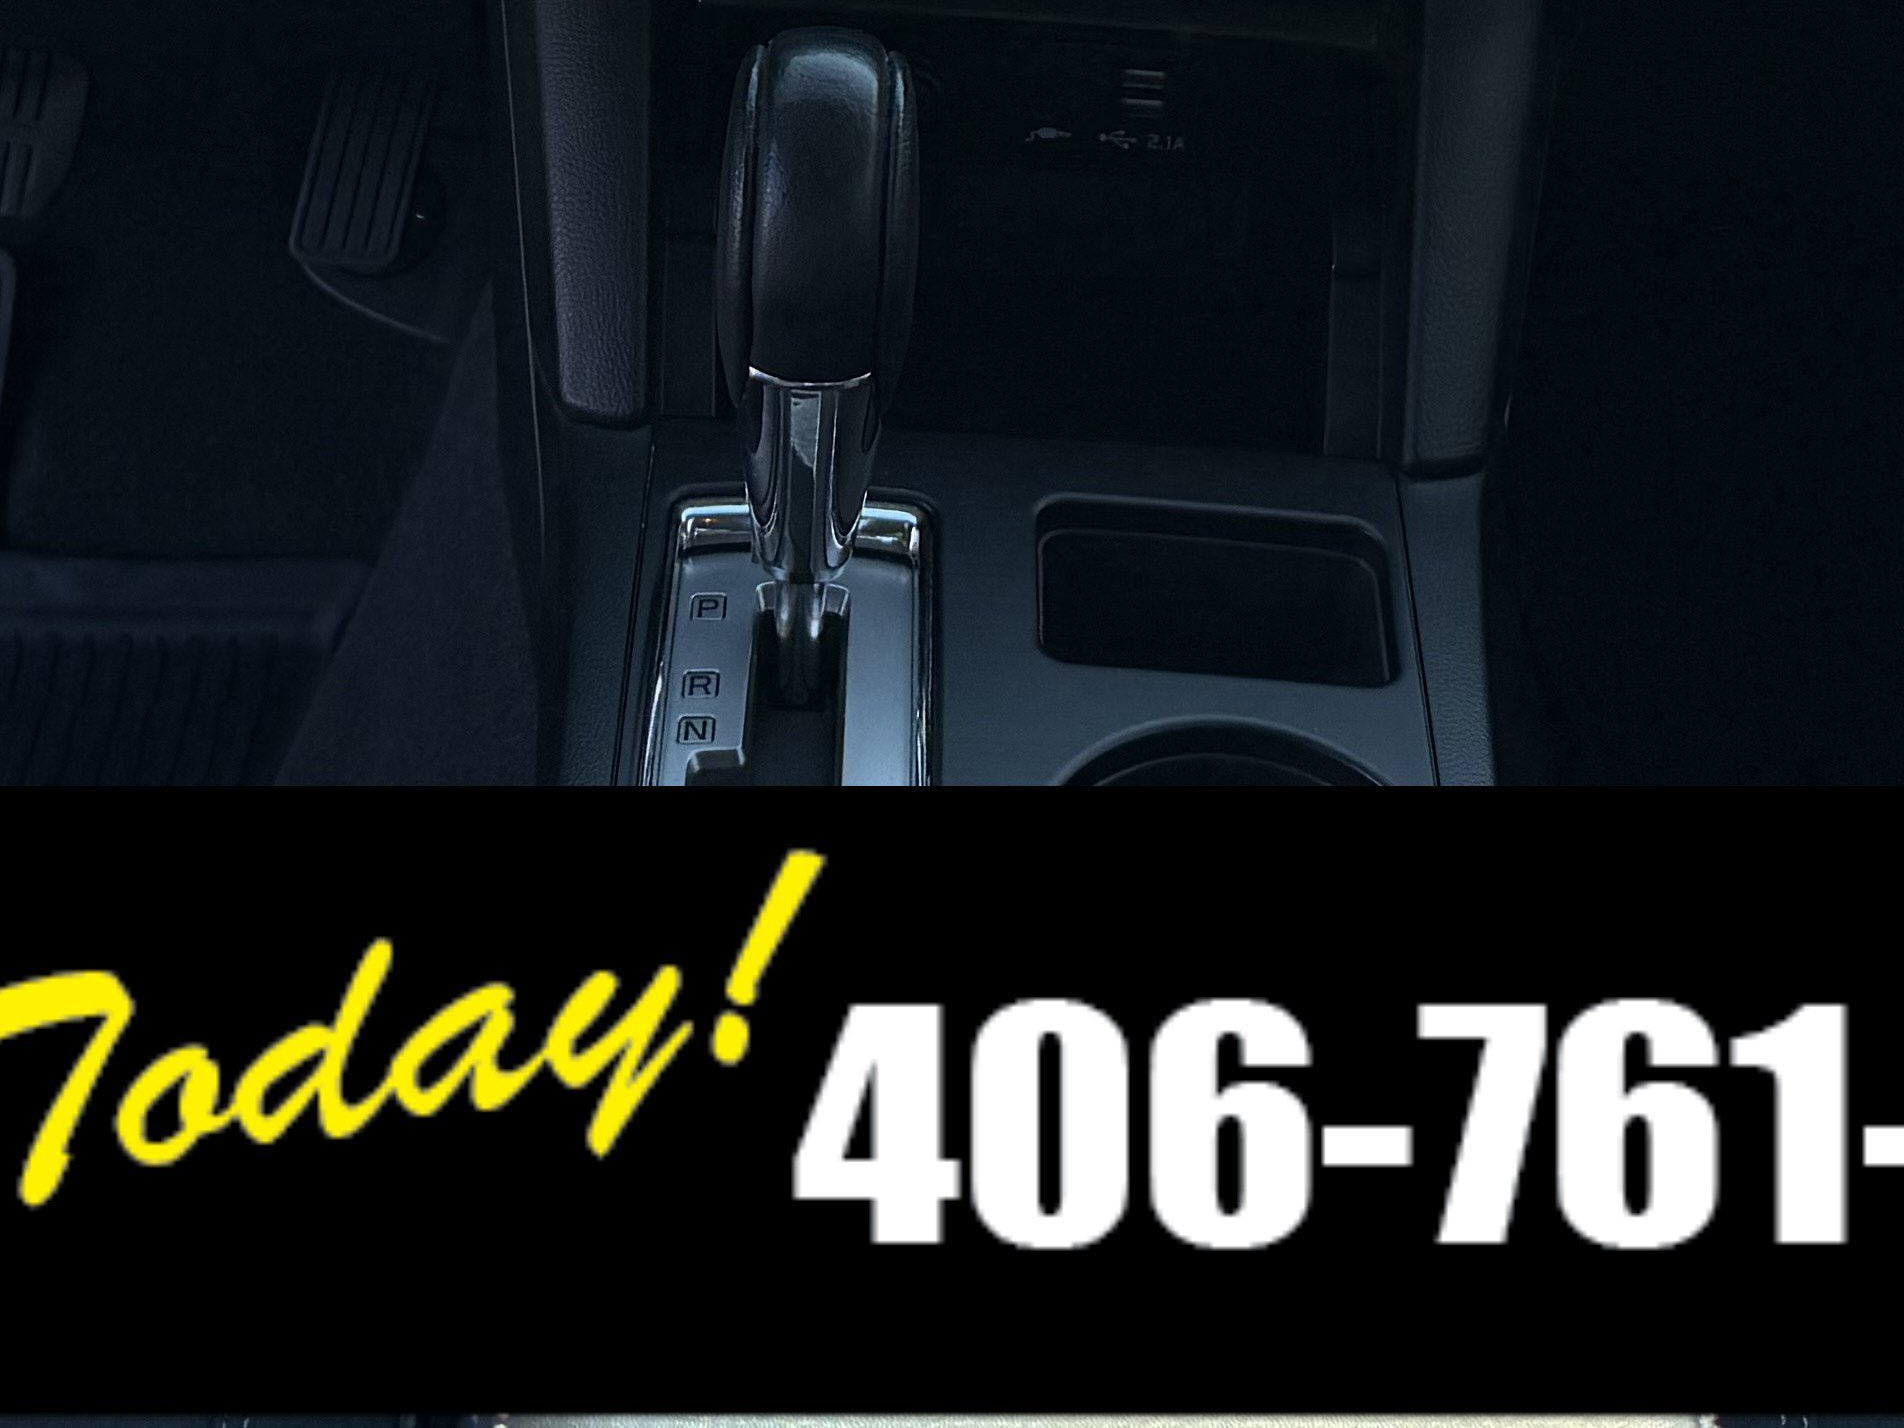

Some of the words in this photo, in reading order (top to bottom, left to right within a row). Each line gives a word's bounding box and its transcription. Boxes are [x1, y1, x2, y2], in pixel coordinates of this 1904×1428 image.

[697, 599, 719, 618] P
[688, 675, 712, 696] R
[683, 720, 708, 741] N
